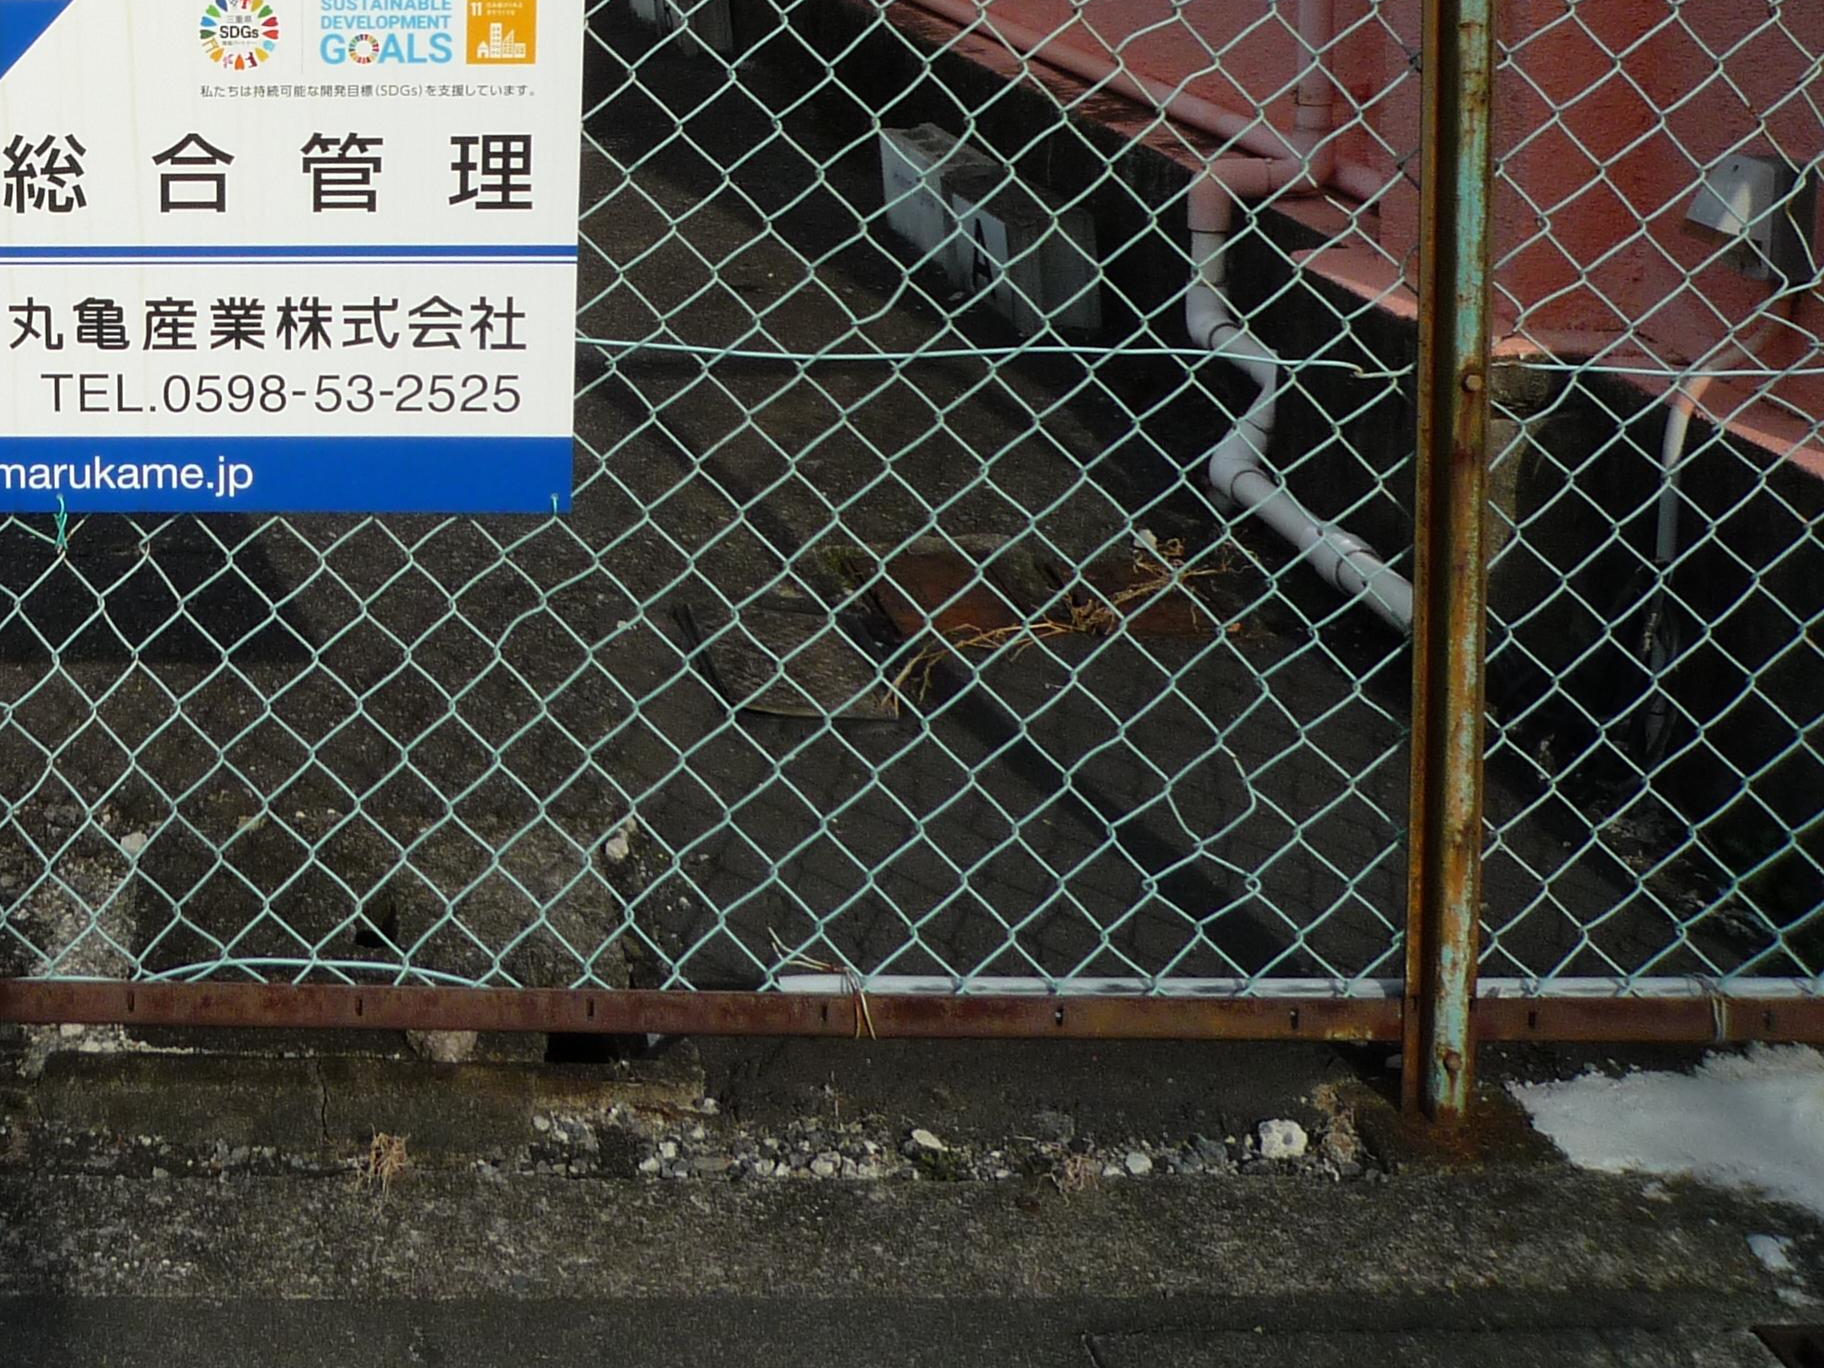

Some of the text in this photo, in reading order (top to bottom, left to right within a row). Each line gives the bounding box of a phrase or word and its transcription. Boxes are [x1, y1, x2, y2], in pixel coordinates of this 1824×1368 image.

[219, 25, 259, 39] SDGs
[320, 15, 452, 30] DEVELOPMENT
[319, 32, 453, 65] GOALS
[2, 132, 533, 215] 総合管理
[7, 294, 527, 352] 丸亀産業株式会社
[40, 374, 522, 414] TEL.0598-53-2525
